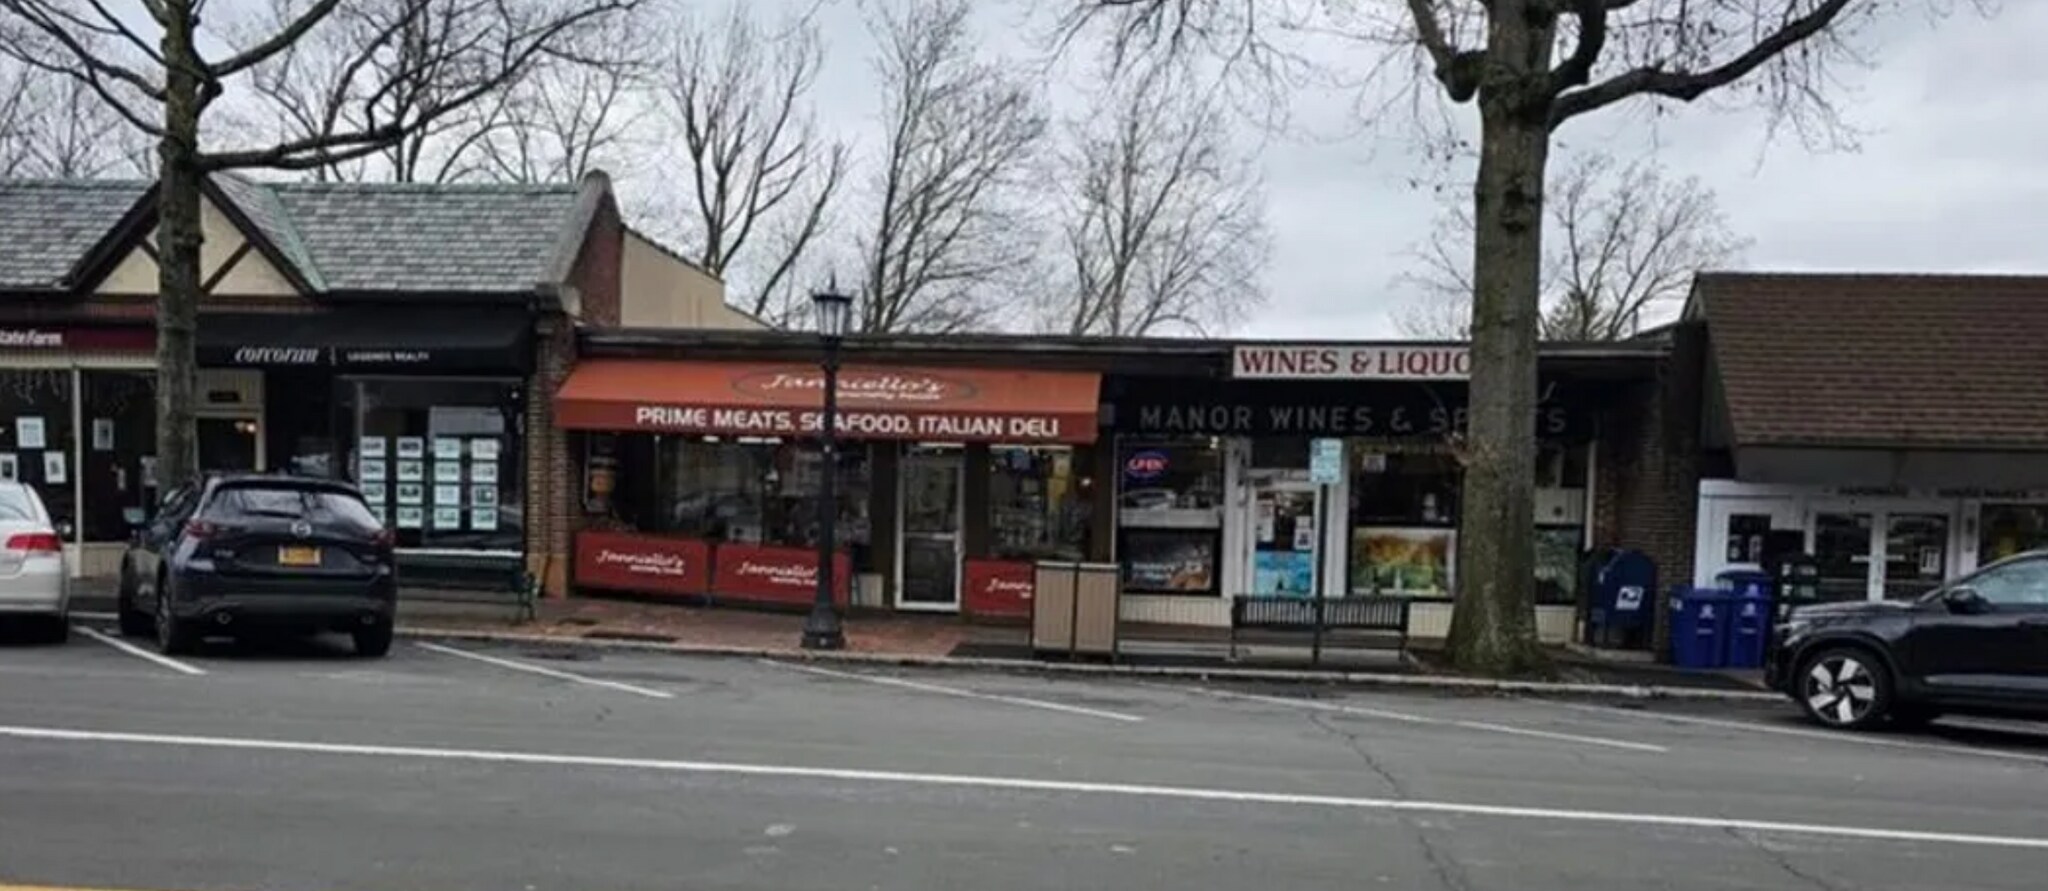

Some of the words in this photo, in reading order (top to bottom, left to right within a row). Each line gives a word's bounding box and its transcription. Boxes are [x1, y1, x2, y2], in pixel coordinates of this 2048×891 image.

[1240, 350, 1339, 374] WINES
[1350, 351, 1371, 374] &
[1379, 351, 1472, 376] LIQUO
[636, 407, 707, 427] PRIME
[918, 415, 1002, 435] ITALIAN
[1009, 417, 1059, 437] DELI
[1140, 405, 1251, 430] MANOR
[1270, 406, 1374, 431] WINES
[1390, 407, 1412, 432] &
